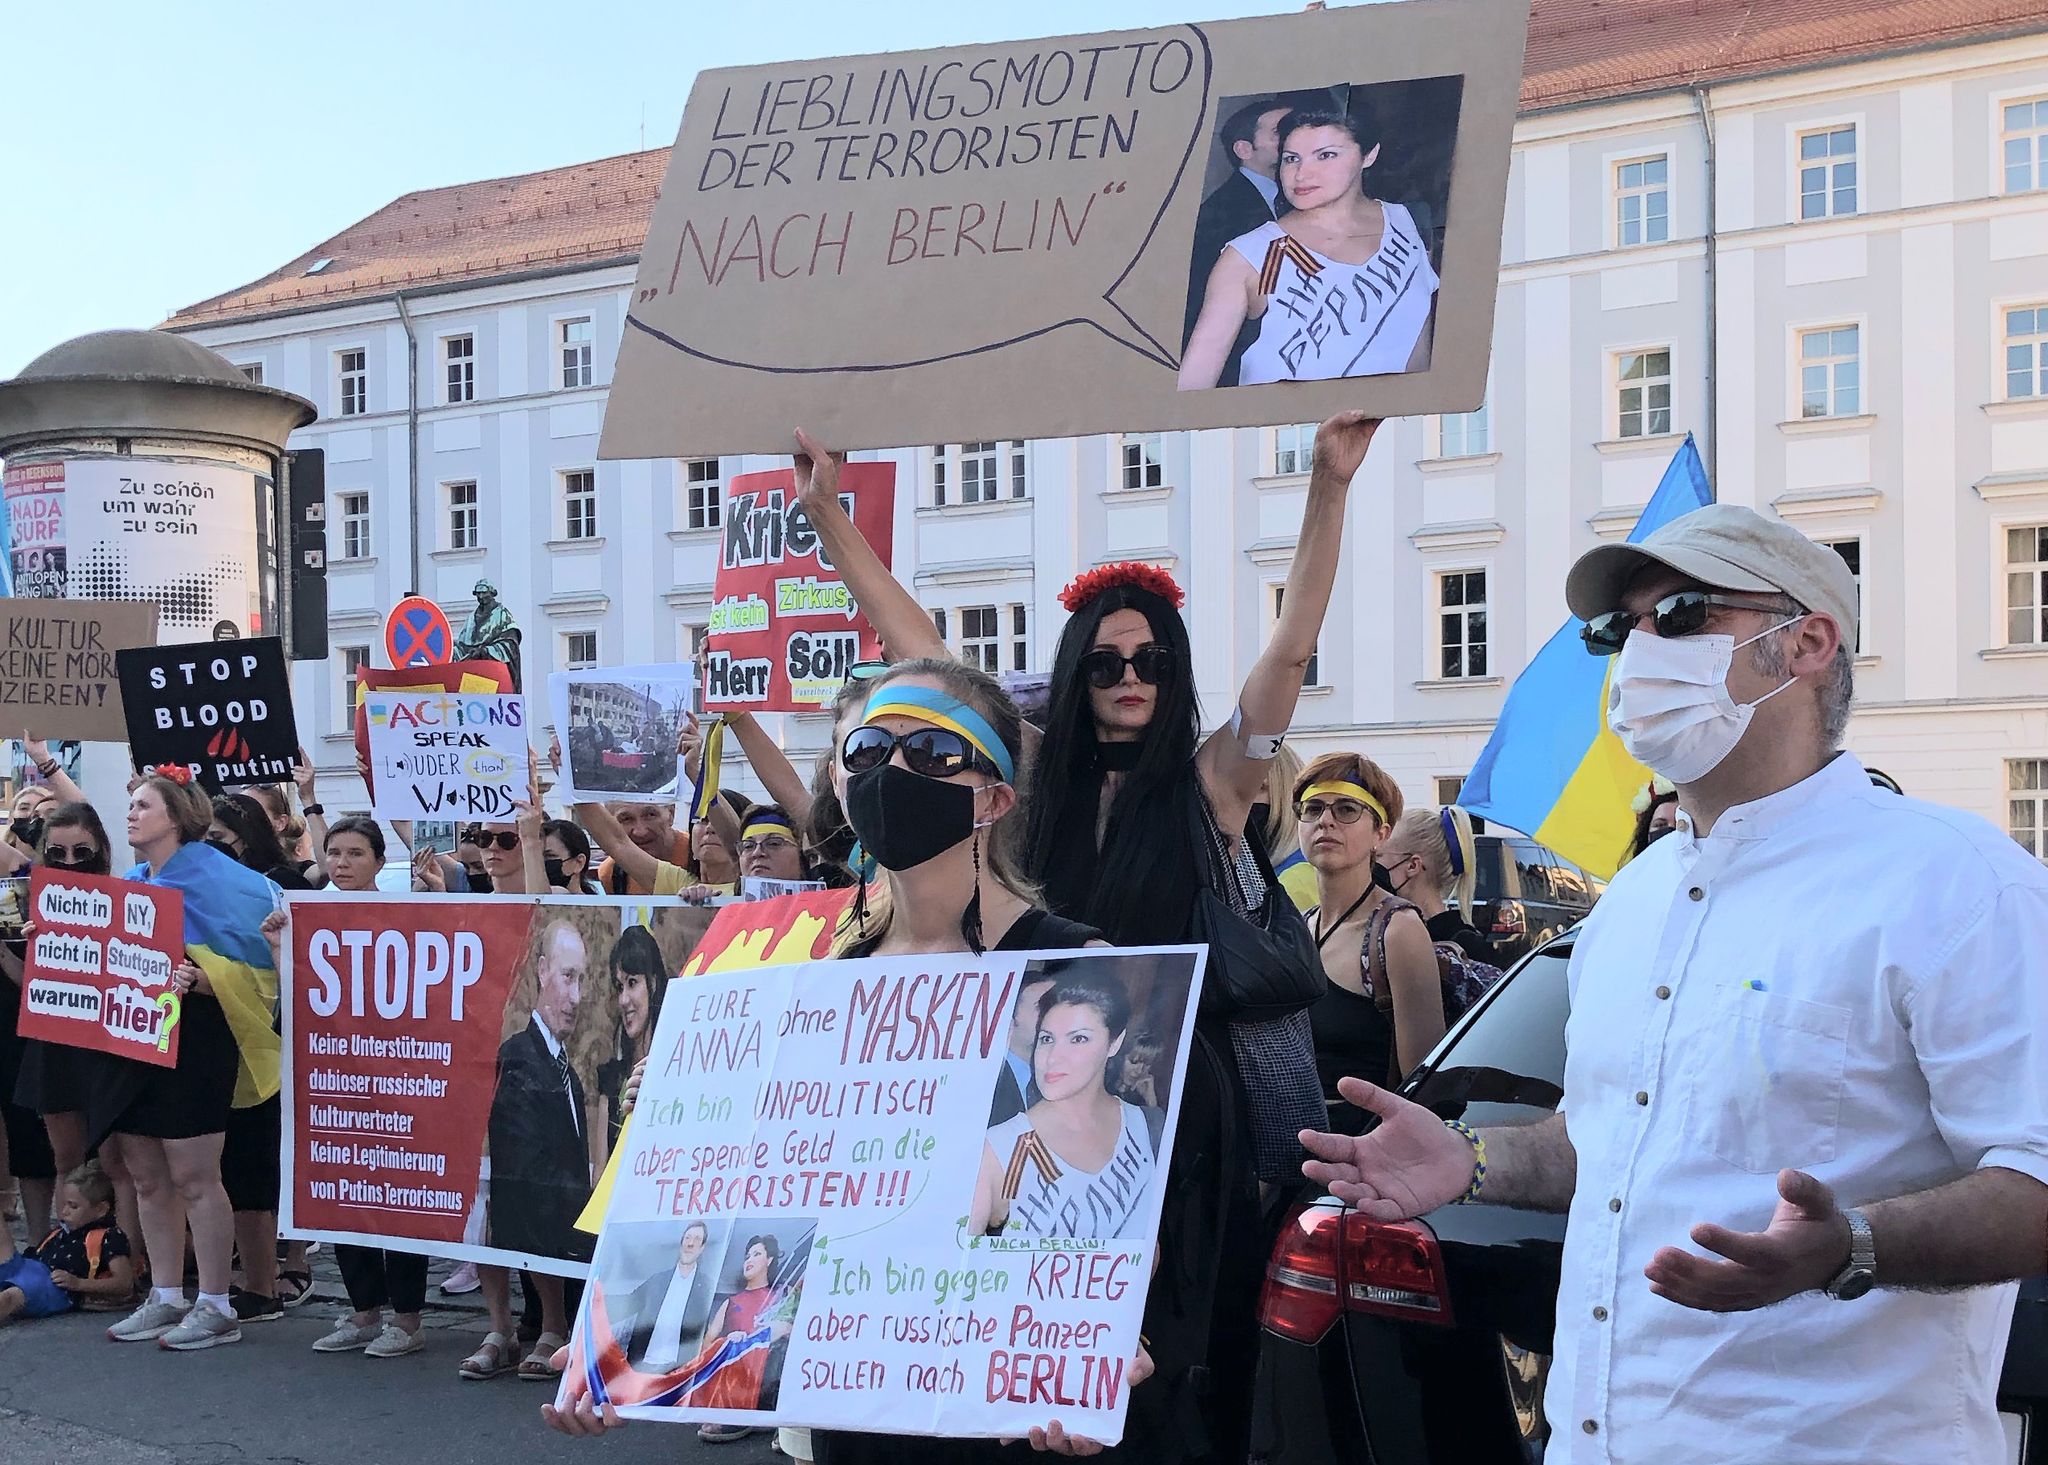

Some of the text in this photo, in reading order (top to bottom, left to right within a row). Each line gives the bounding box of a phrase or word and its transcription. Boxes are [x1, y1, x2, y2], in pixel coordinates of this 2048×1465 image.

[712, 39, 1194, 141] LIEBLINGSMOTTO
[698, 109, 1139, 192] DER TERRORISTEN
[1278, 222, 1418, 377] БЕРЛИН!
[120, 478, 214, 499] Zu schön
[13, 498, 62, 521] NADA
[103, 499, 196, 516] um wahr
[16, 519, 60, 543] SURF
[123, 518, 198, 535] zu sein
[16, 570, 65, 585] ANTILOPEN
[710, 583, 854, 629] st kein Zirkus,
[9, 616, 105, 651] KULTUR
[66, 651, 120, 680] MÖR
[149, 655, 259, 690] STOP
[710, 657, 768, 697] Herr
[0, 681, 108, 707] ZIEREN!
[155, 699, 268, 729] BLOOD
[414, 731, 490, 747] SPEAK
[143, 754, 295, 781] SP putin!
[46, 893, 151, 930] Nicht in NY,
[38, 942, 171, 978] nicht in Stuttgart
[308, 928, 484, 1021] STOPP
[30, 987, 99, 1011] warum
[691, 988, 757, 1022] EURE
[664, 971, 1016, 1077] ANNA ohne MASKEN
[309, 1032, 451, 1066] Keine Unterstützung
[309, 1068, 448, 1098] dubioser russischer
[309, 1104, 414, 1133] Kulturvertreter
[697, 1093, 733, 1122] bin
[310, 1140, 446, 1176] Keine Legitimierung
[634, 1127, 936, 1177] aber spende Geld an die
[310, 1178, 463, 1211] von Putins Terrorismus
[989, 1239, 1030, 1249] NACH
[886, 1256, 925, 1295] bin
[934, 1268, 1009, 1305] gegen
[807, 1304, 1111, 1349] aber russische Panzer
[906, 1358, 965, 1394] nach
[986, 1349, 1124, 1410] BERLIN
